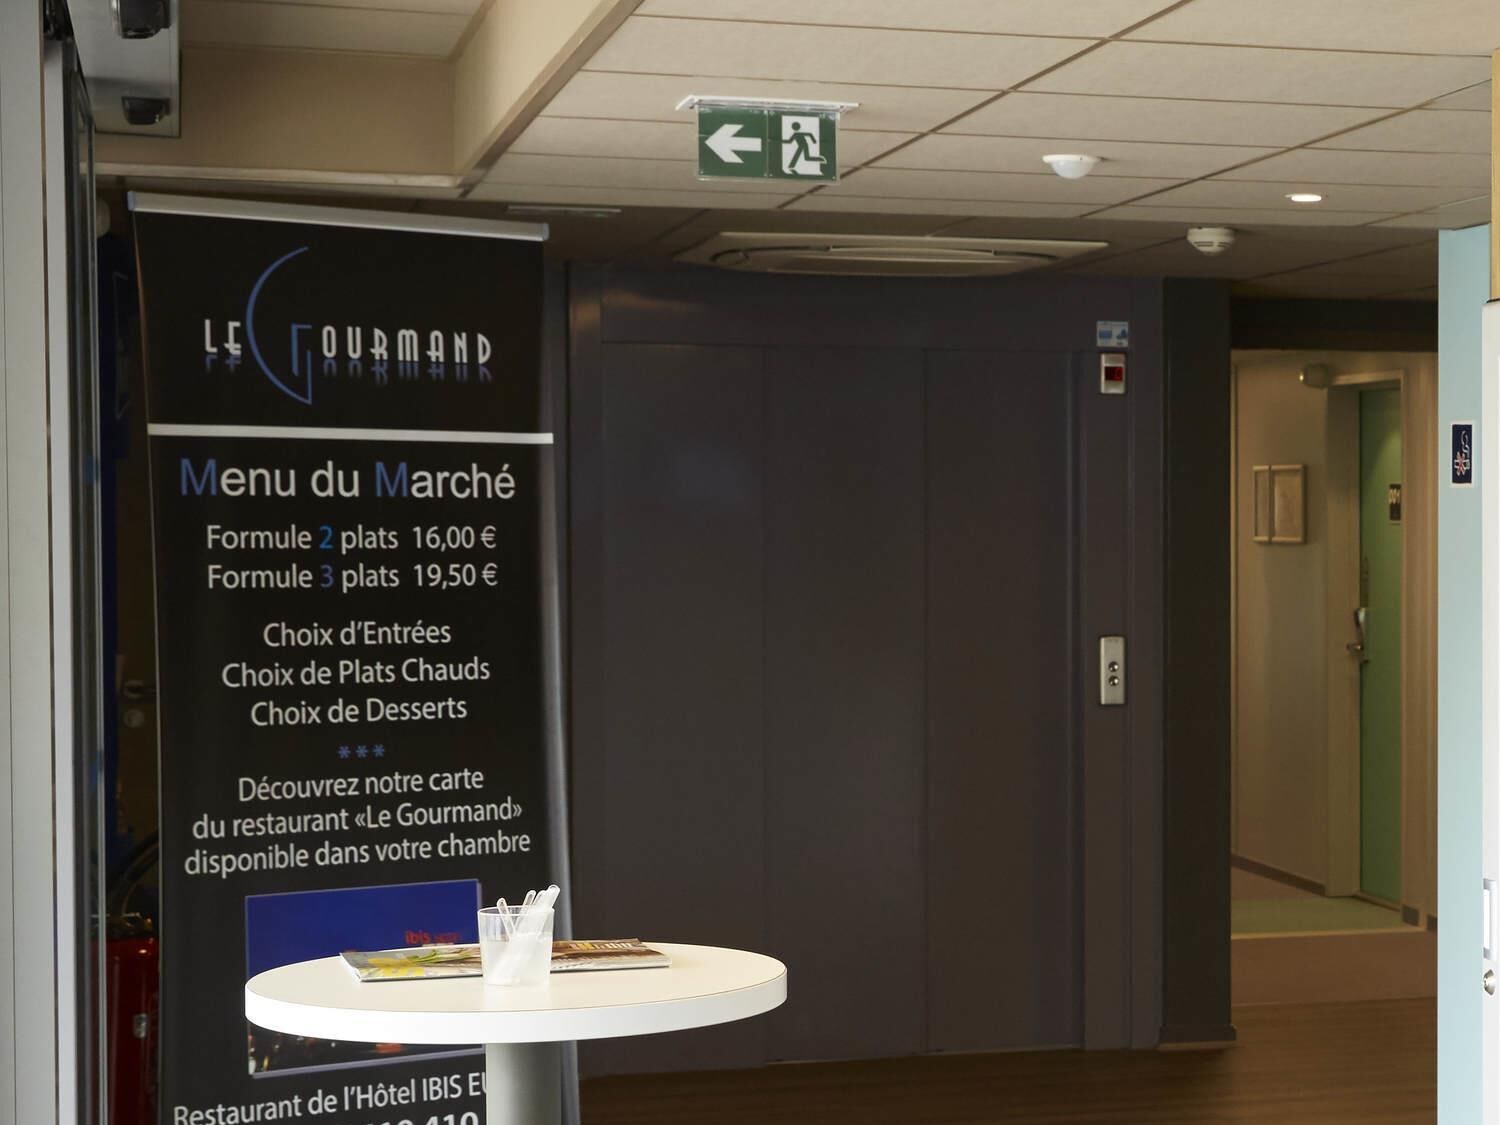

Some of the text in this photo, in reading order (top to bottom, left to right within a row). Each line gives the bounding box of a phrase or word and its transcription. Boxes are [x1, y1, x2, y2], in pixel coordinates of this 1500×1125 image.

[204, 318, 242, 356] LE
[179, 457, 516, 500] Menu du Marché
[207, 524, 498, 555] Formule 2 plats 16,00 €
[207, 563, 499, 594] Formule 3 plats 19,50 €
[263, 619, 452, 647] Choix d'Entrées
[221, 656, 491, 688] Choix de Plats Chauds
[250, 696, 468, 726] Choix de Desserts
[238, 766, 485, 802] Découvrez notre carte
[192, 795, 523, 839] du restaurant «Le Gourmand»
[184, 829, 531, 879] disponible dans votre chambre
[307, 1090, 338, 1115] de
[343, 1077, 417, 1112] l'Hôtel
[422, 1074, 462, 1101] IBIS
